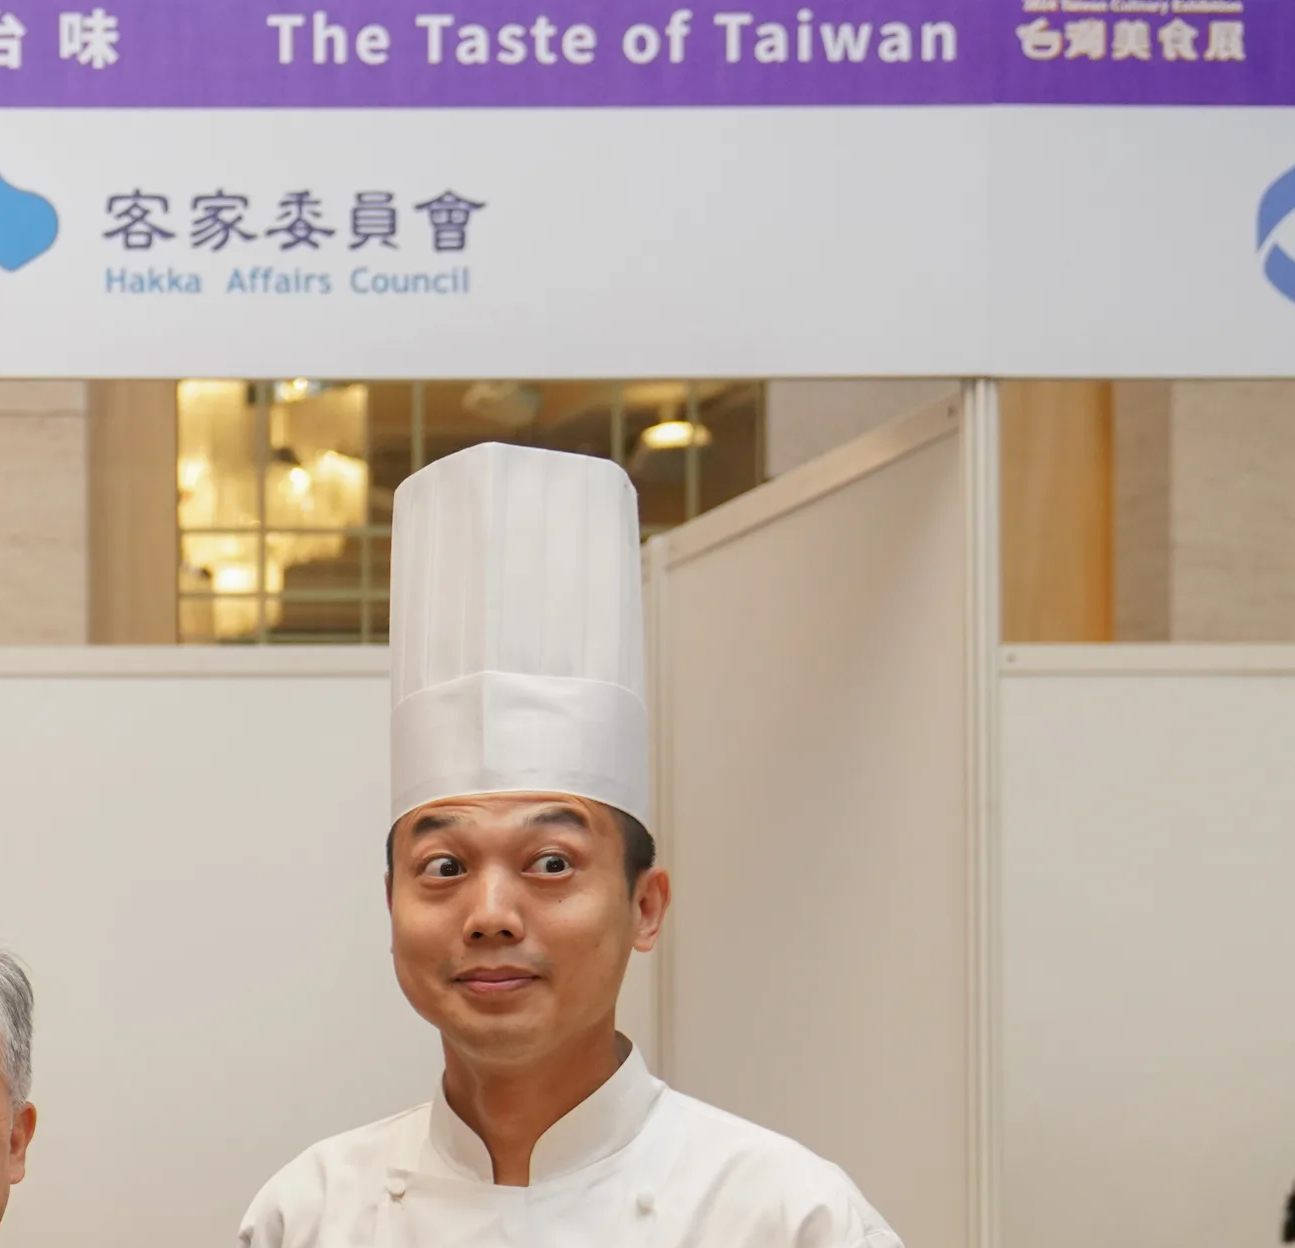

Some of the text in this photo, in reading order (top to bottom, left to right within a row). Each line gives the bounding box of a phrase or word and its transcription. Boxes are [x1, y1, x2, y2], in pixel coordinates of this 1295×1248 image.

[267, 10, 958, 66] The Taste of Taiwan
[1015, 17, 1247, 62] 台灣美食展
[103, 189, 488, 255] 客家委員會
[106, 267, 472, 296] Hakka Affairs Council
